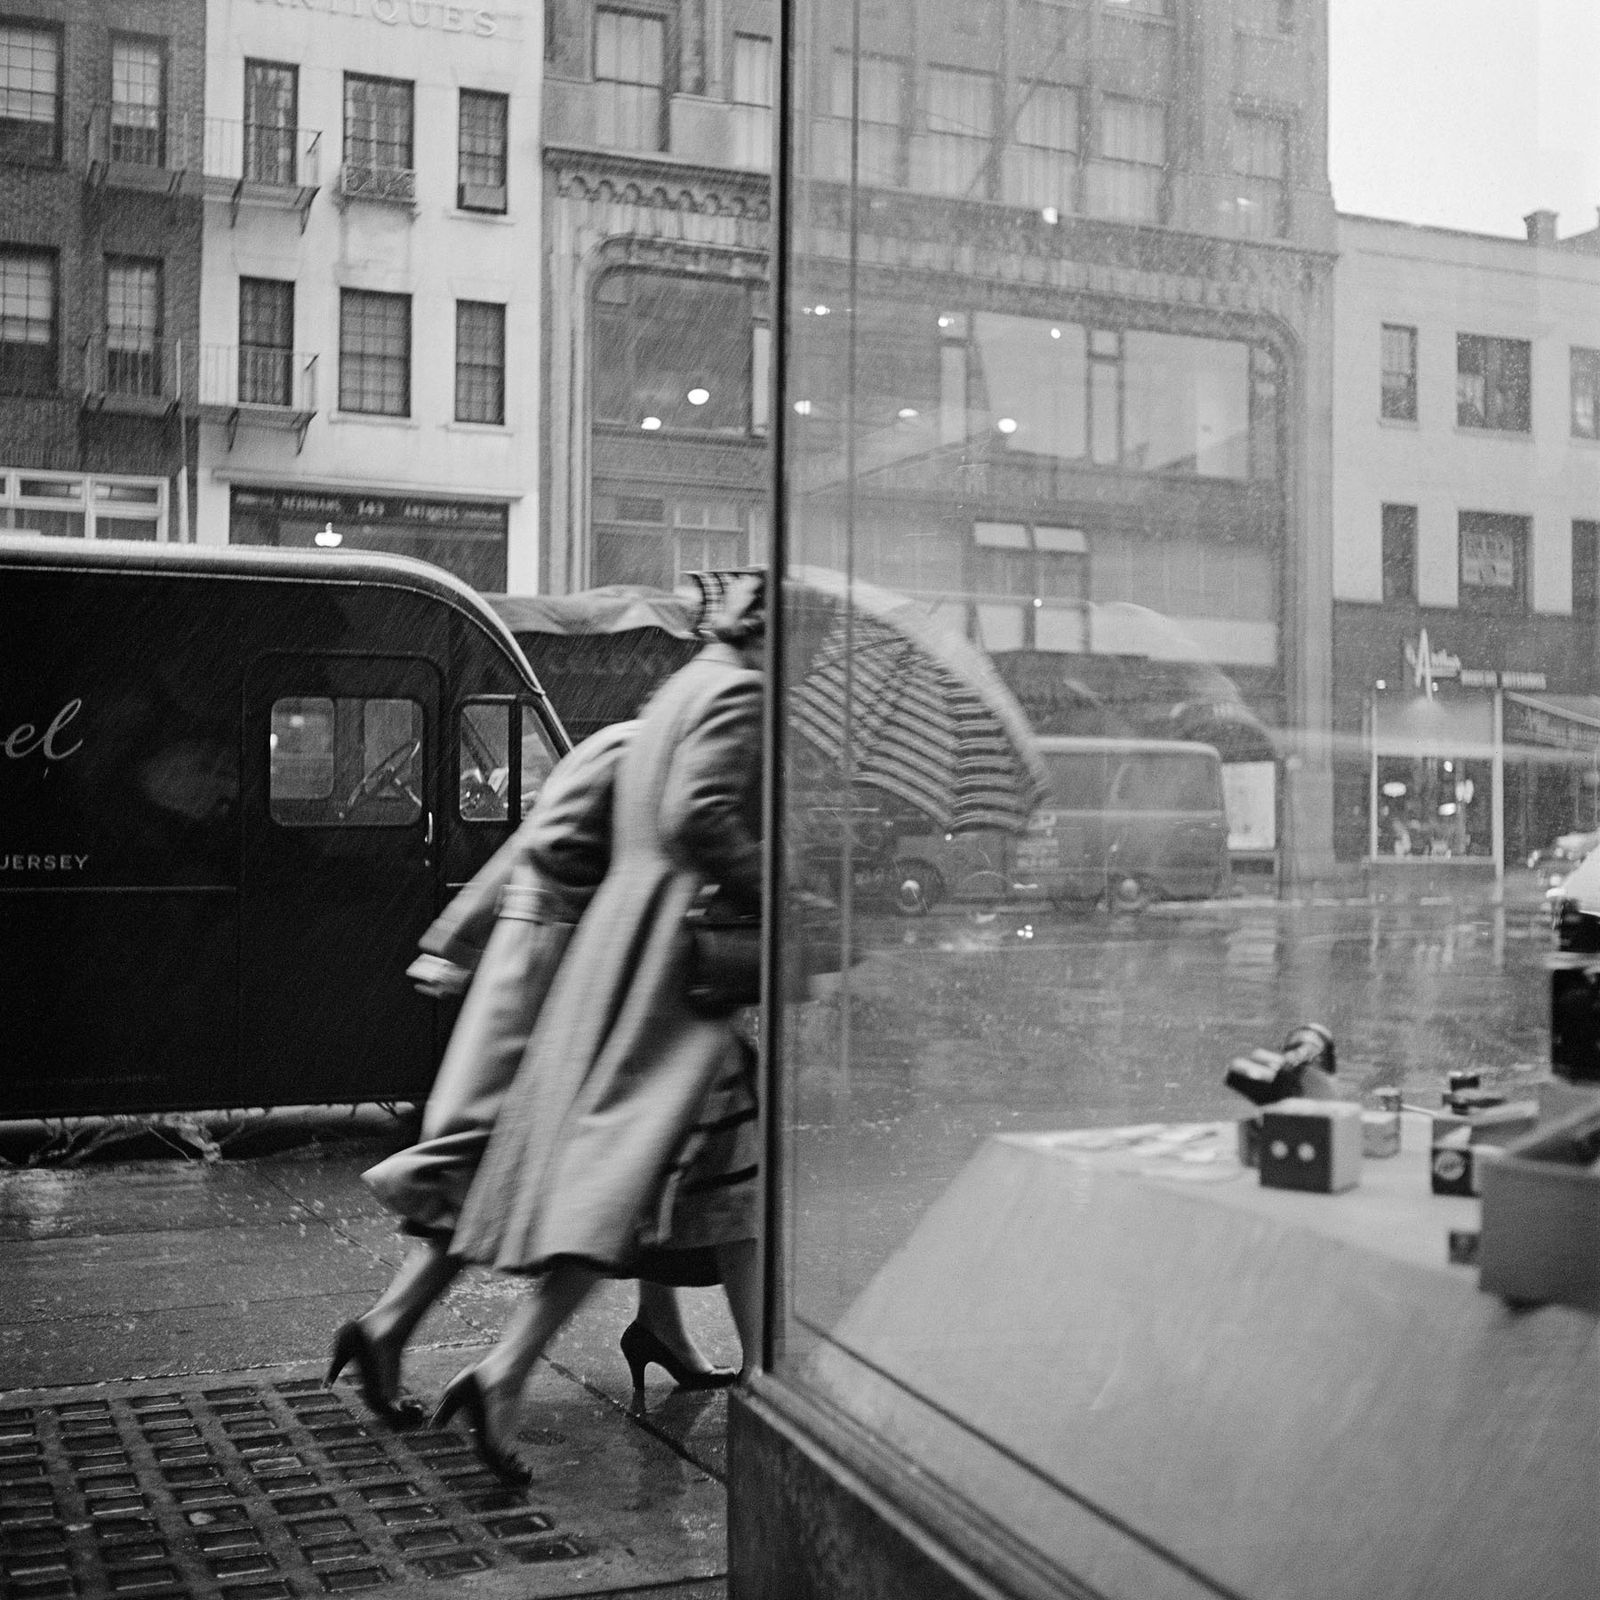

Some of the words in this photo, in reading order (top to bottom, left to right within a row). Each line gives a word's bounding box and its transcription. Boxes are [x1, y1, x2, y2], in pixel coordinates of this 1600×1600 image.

[253, 0, 498, 39] IQUES
[0, 697, 84, 760] el
[0, 853, 90, 871] JERSEY
